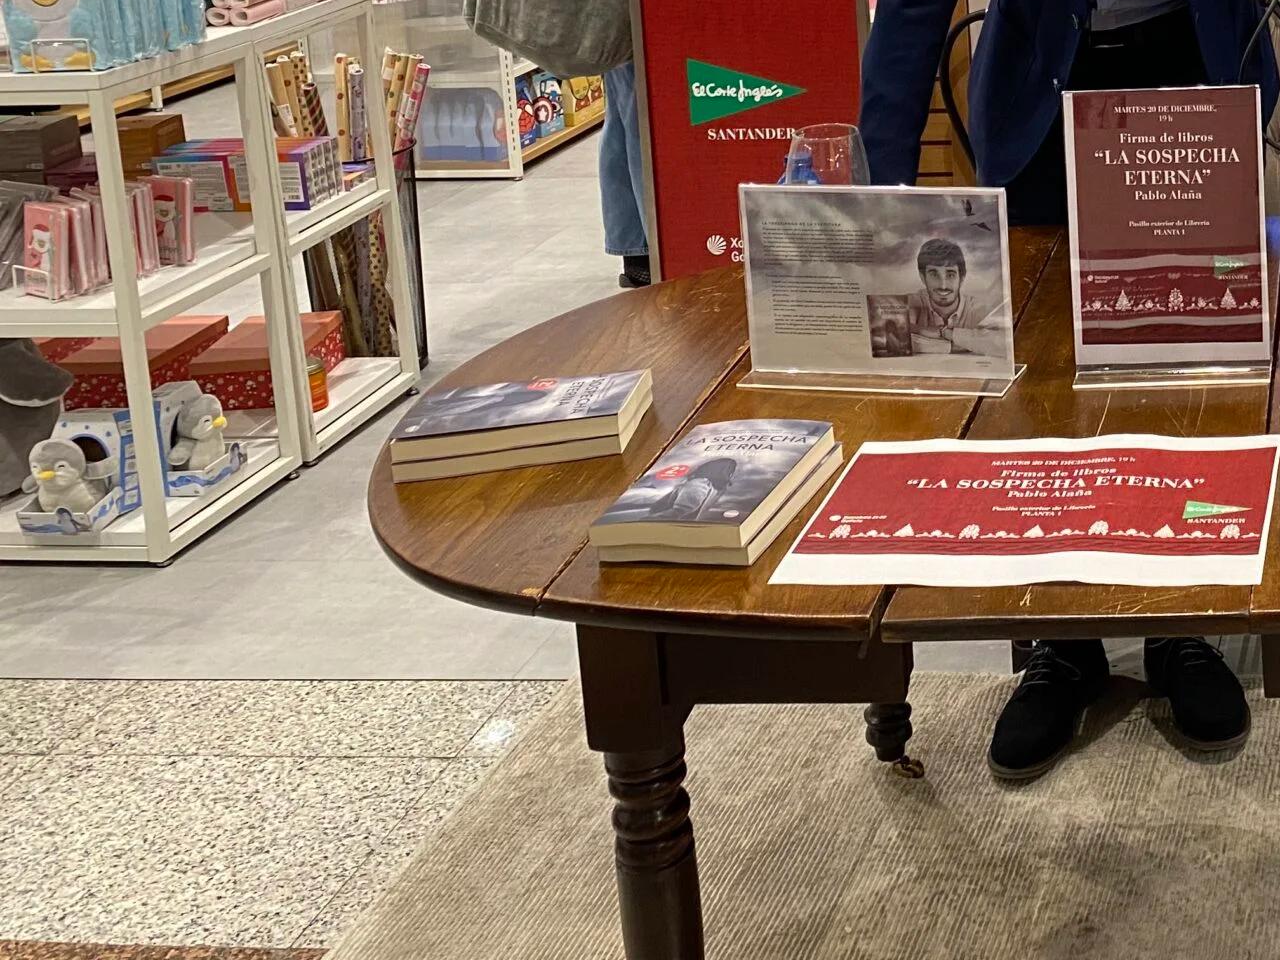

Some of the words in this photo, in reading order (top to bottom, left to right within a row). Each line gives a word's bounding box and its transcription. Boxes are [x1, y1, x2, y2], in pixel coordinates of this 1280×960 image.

[1114, 105, 1146, 114] MARTES
[1147, 105, 1157, 113] 20
[1158, 105, 1170, 113] DE
[708, 127, 797, 141] SANTANDER
[1120, 133, 1156, 144] Firma
[1160, 132, 1174, 143] de
[1178, 131, 1214, 143] libros
[1135, 147, 1241, 165] SOSPECHA
[1134, 190, 1167, 200] Pablo
[1169, 189, 1202, 200] Alaña
[1153, 228, 1181, 236] PLANTA
[687, 438, 706, 446] LA
[711, 435, 808, 444] SOSPECHA
[704, 443, 774, 452] ETERNA
[1001, 469, 1046, 478] Firma
[1050, 469, 1069, 477] de
[1073, 466, 1117, 476] libros
[956, 477, 1087, 490] SOSPECHA
[1007, 489, 1048, 498] Pablo
[1050, 488, 1093, 498] Alaña
